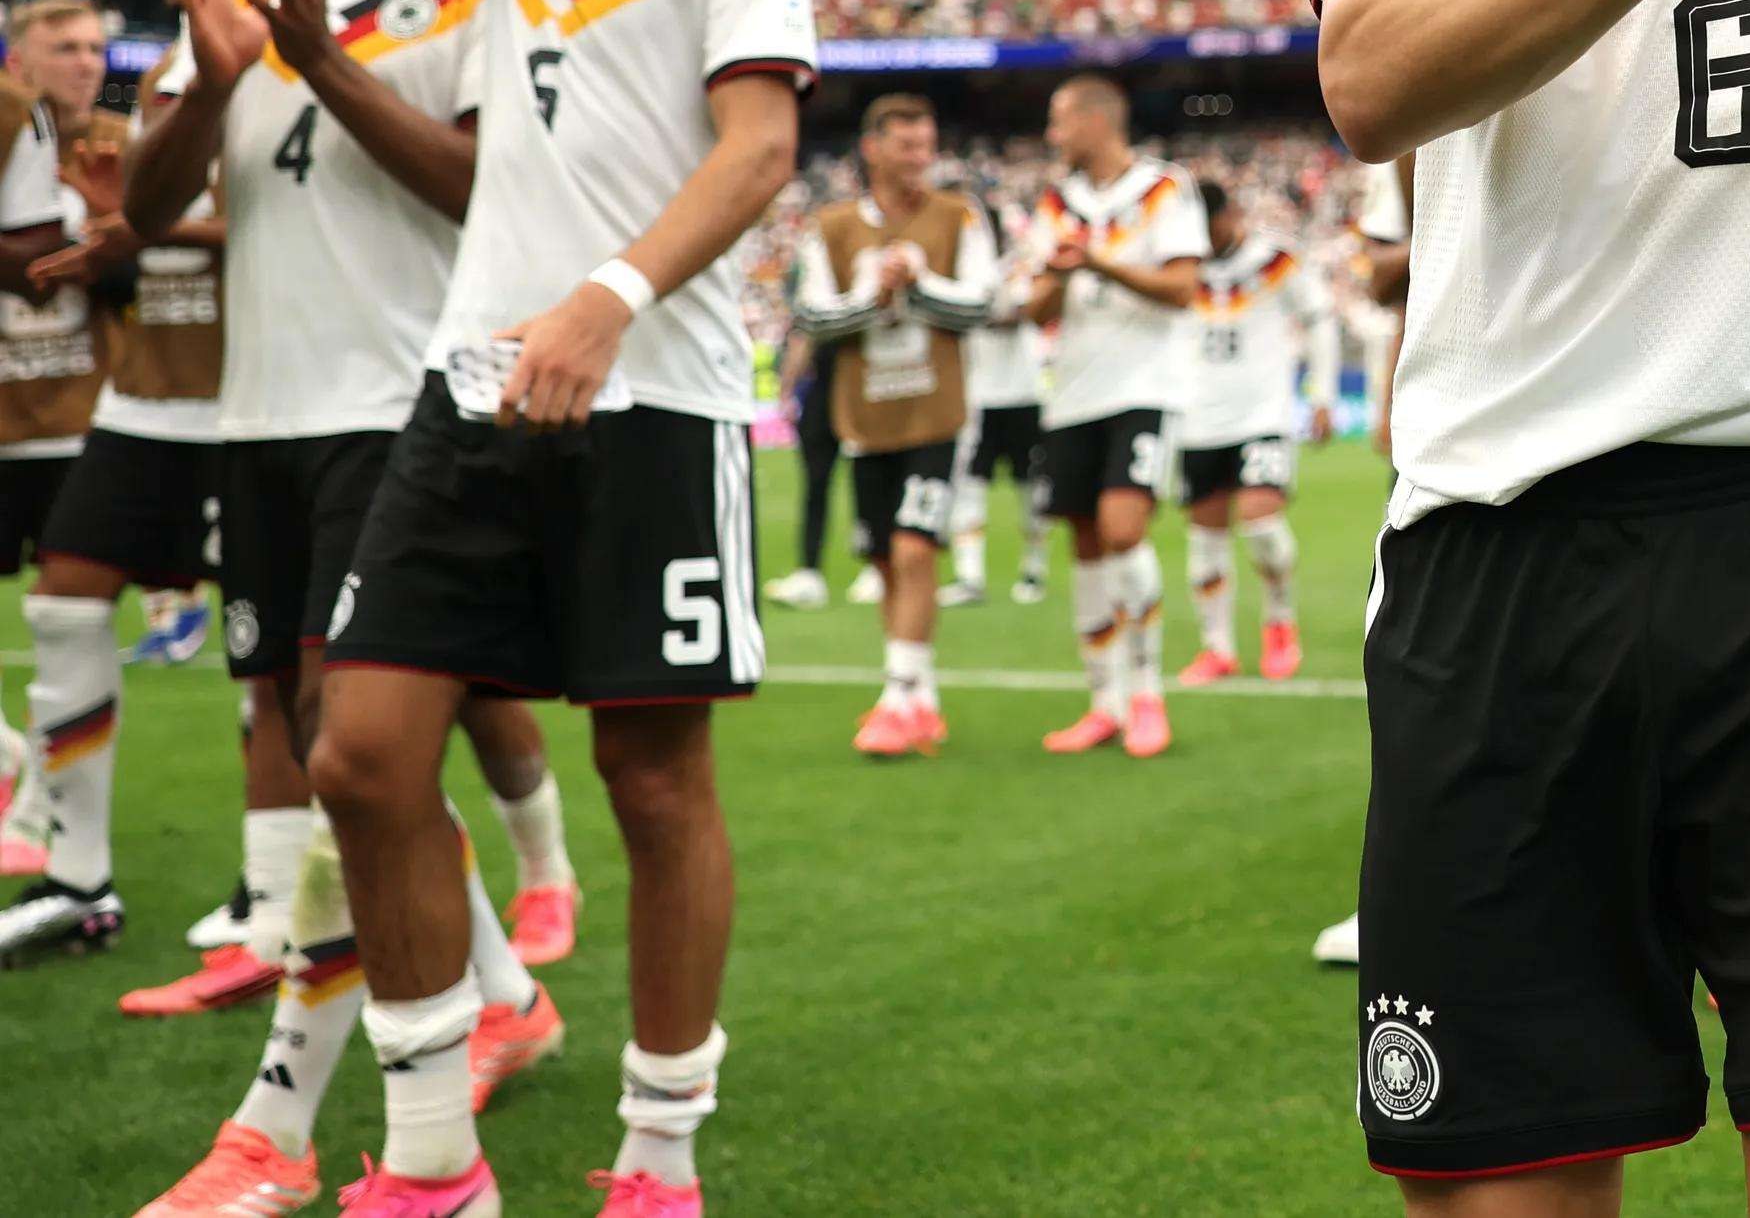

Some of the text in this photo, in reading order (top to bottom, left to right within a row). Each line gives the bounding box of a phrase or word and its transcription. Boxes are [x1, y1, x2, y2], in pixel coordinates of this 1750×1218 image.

[273, 105, 318, 184] 4
[662, 558, 722, 666] 5
[1375, 1034, 1416, 1053] DEUTSCHER
[1375, 1080, 1427, 1108] FUSSBALL-BUND
